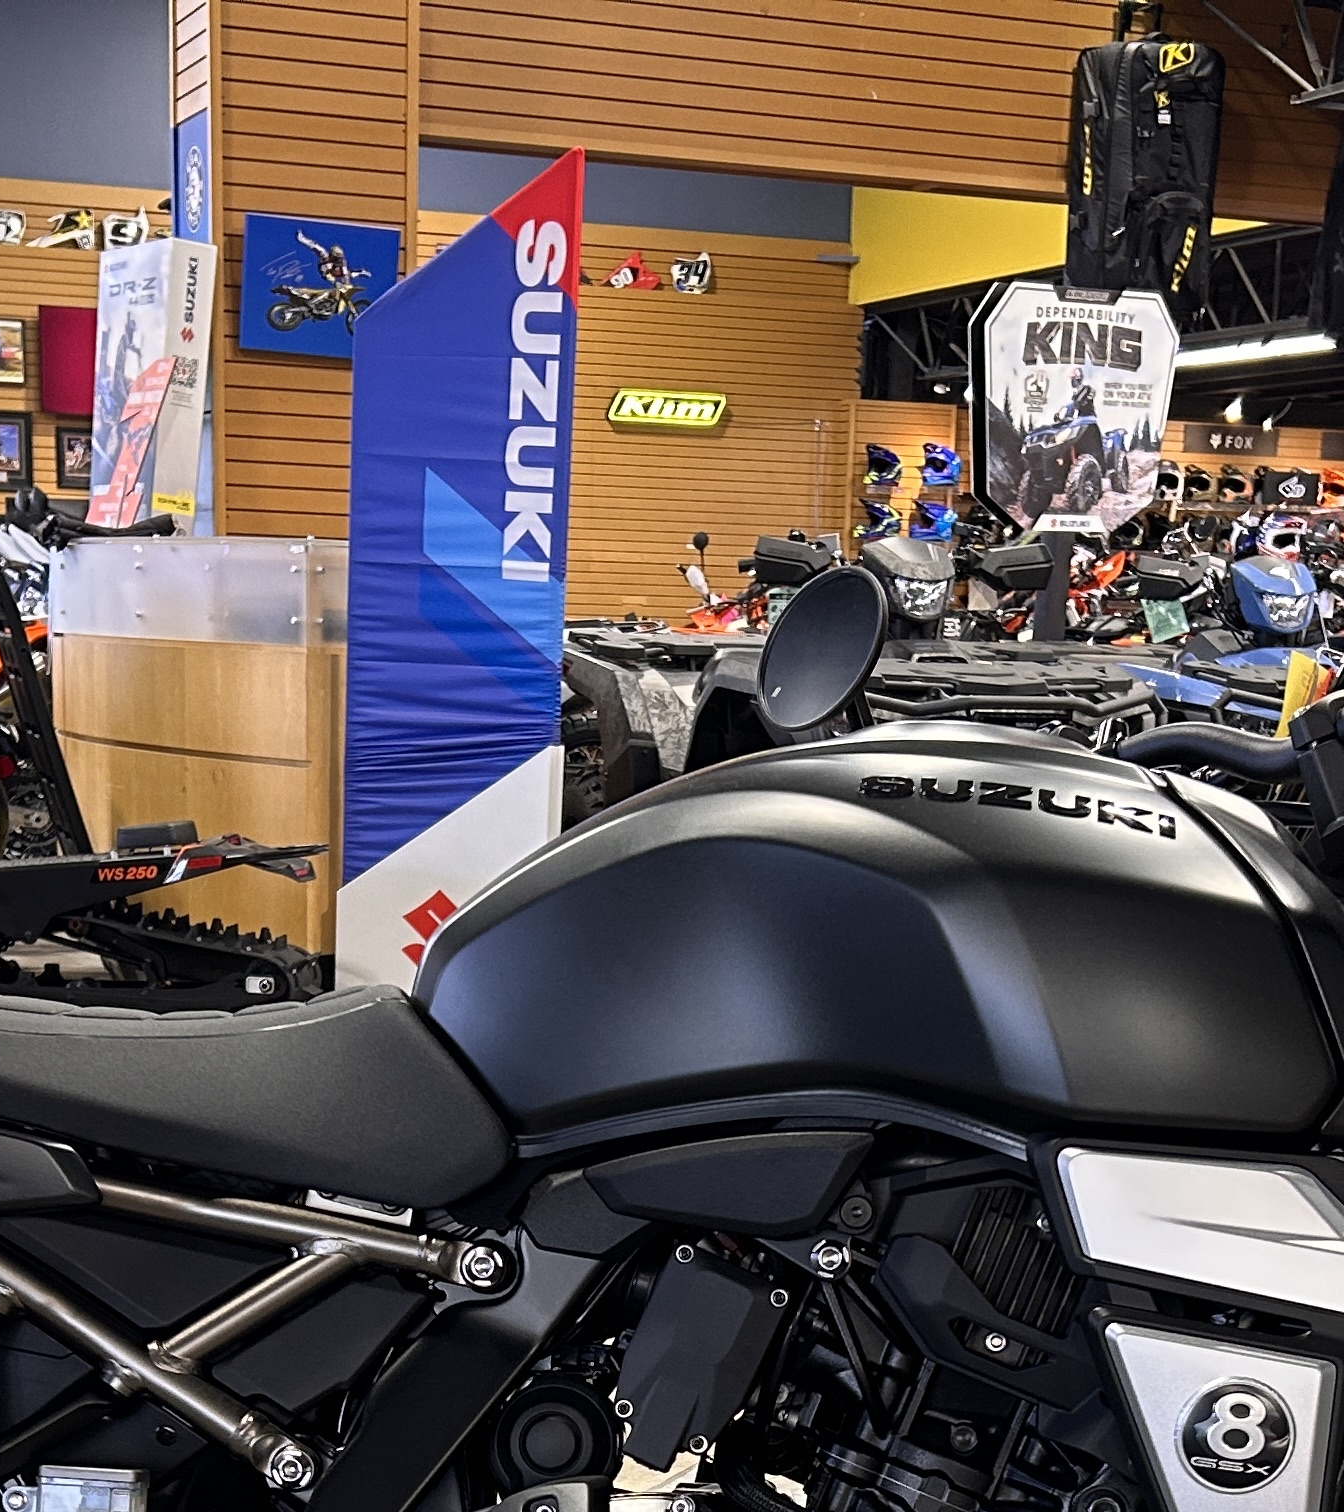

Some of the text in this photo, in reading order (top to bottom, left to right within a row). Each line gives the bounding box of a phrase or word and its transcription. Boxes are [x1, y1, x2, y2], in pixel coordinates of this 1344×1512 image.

[183, 256, 199, 324] SUZUKI
[1036, 306, 1136, 325] DEPENDABILITY
[1022, 321, 1143, 372] KING
[502, 219, 567, 583] SUZUKI
[614, 395, 717, 421] Klim
[1224, 435, 1254, 450] FOX
[858, 775, 1177, 840] SUZUKI
[97, 864, 159, 882] WS 250
[1206, 1392, 1267, 1460] 8
[1190, 1456, 1271, 1476] GSX
